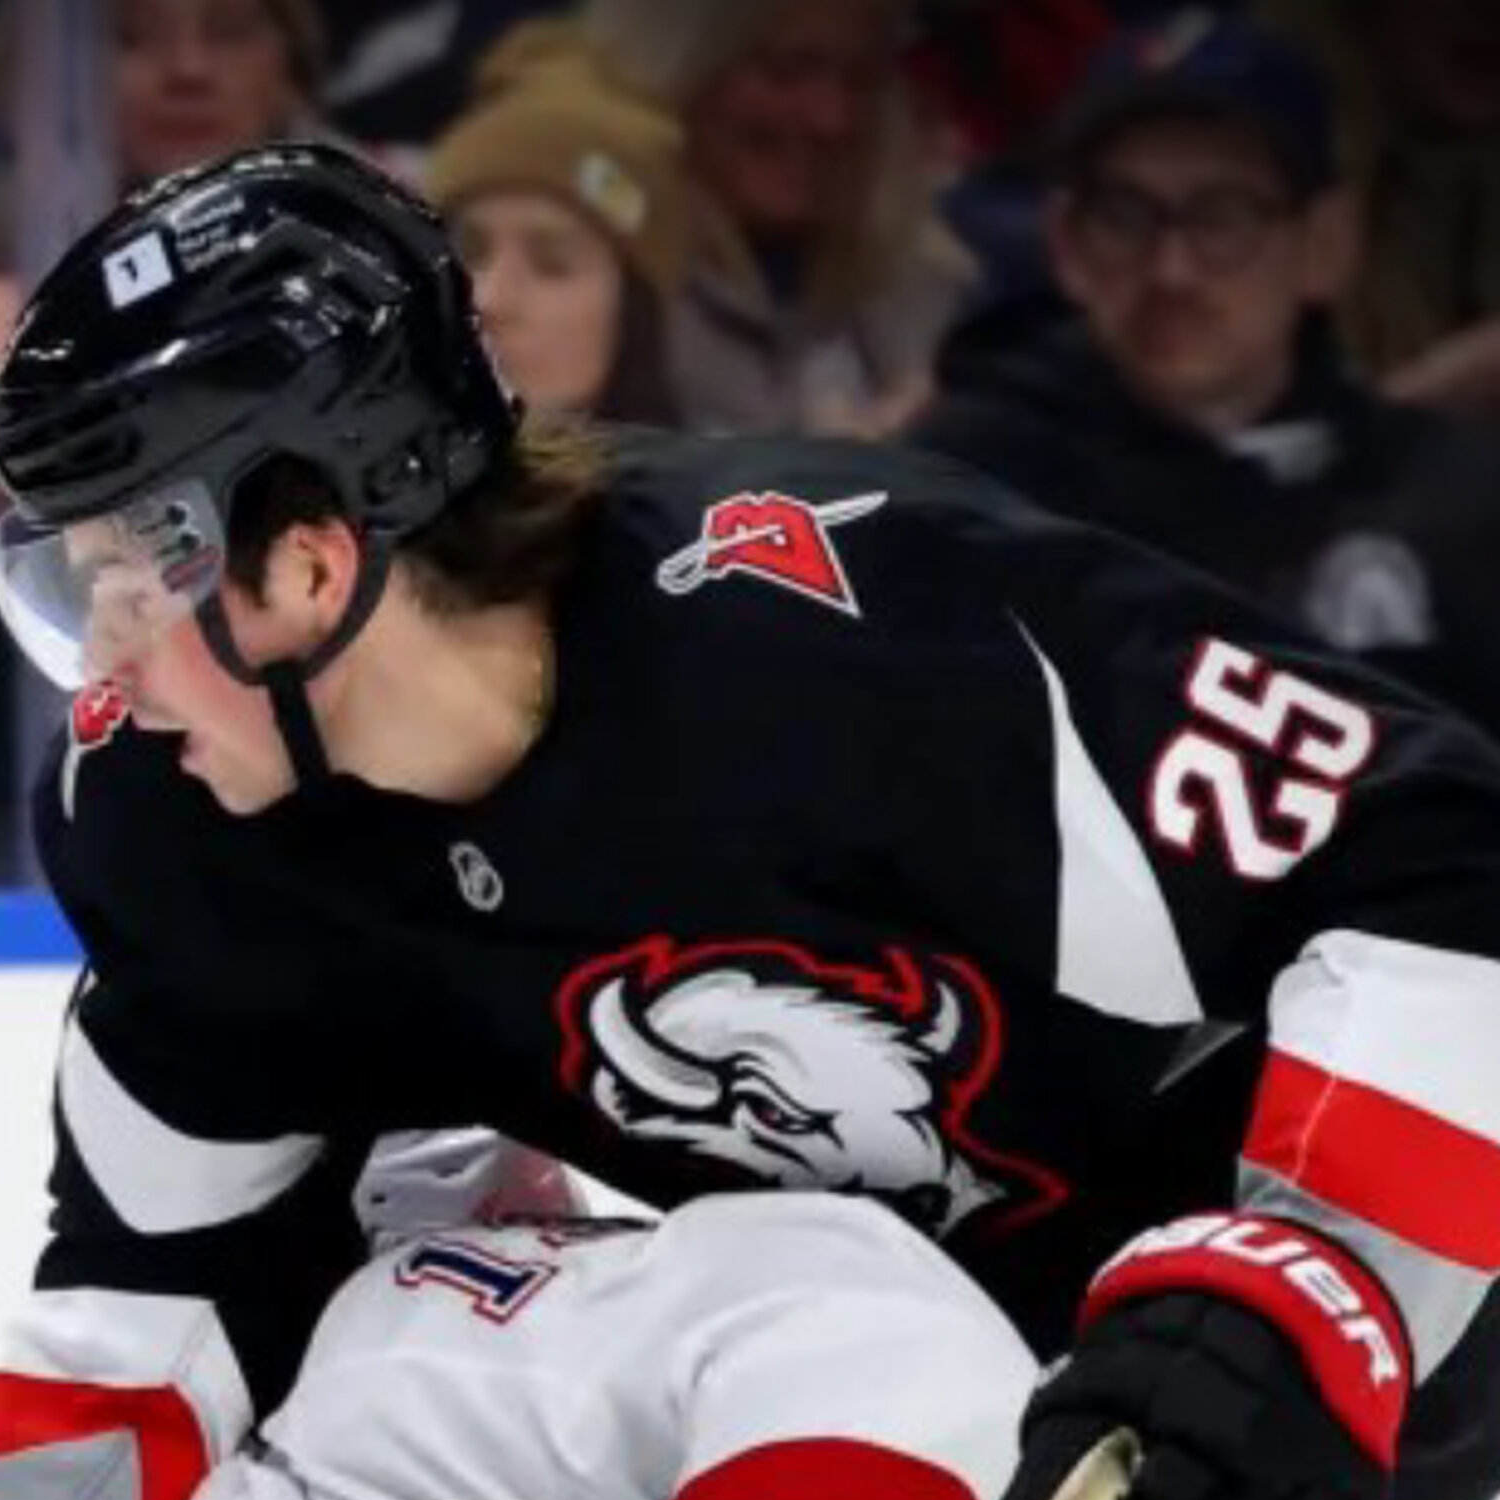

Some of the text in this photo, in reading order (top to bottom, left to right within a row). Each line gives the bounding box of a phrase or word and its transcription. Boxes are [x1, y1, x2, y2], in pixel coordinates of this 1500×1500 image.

[1152, 638, 1376, 881] 25
[394, 1222, 572, 1326] 1
[1090, 1214, 1400, 1388] UER
